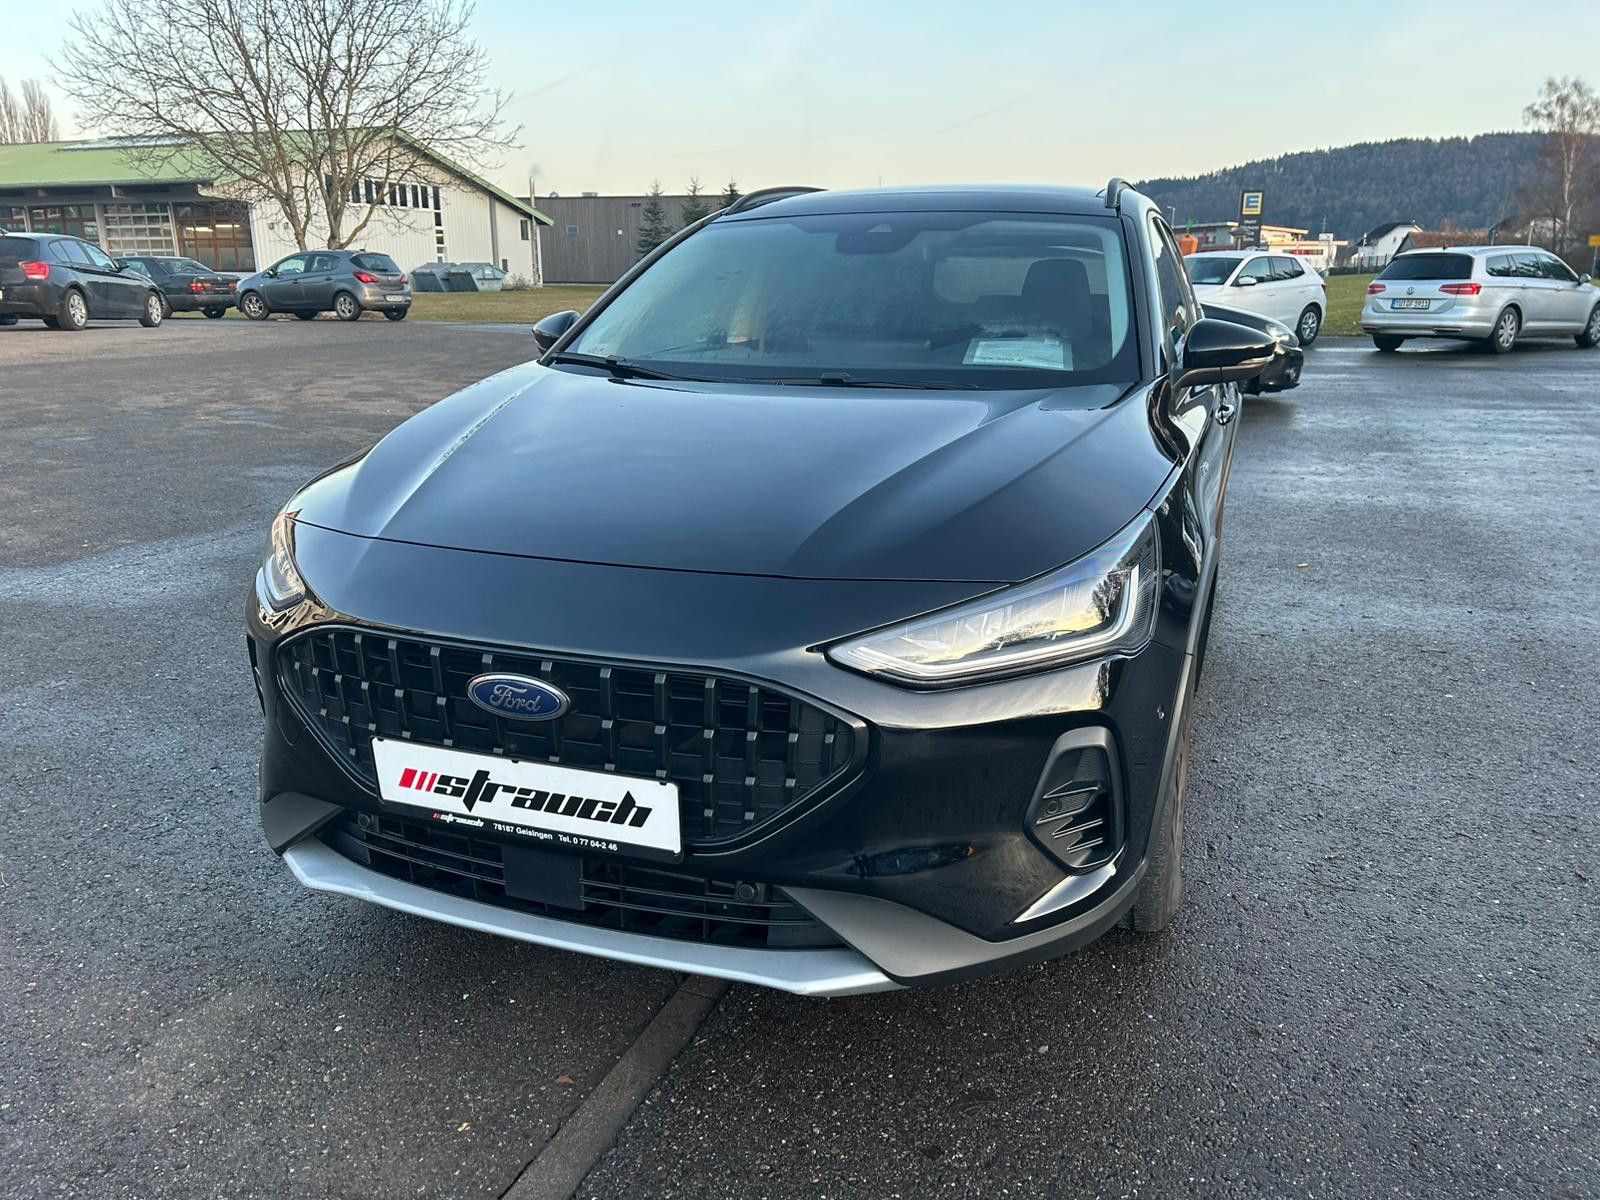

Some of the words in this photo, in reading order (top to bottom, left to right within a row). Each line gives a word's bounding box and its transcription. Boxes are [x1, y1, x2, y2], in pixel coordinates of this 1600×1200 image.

[489, 684, 541, 712] Ford
[433, 769, 653, 828] strauch
[493, 822, 514, 833] 78187
[515, 827, 553, 840] Geisingen
[558, 834, 572, 844] Tel.
[579, 838, 588, 846] 77
[590, 840, 606, 849] 04-2
